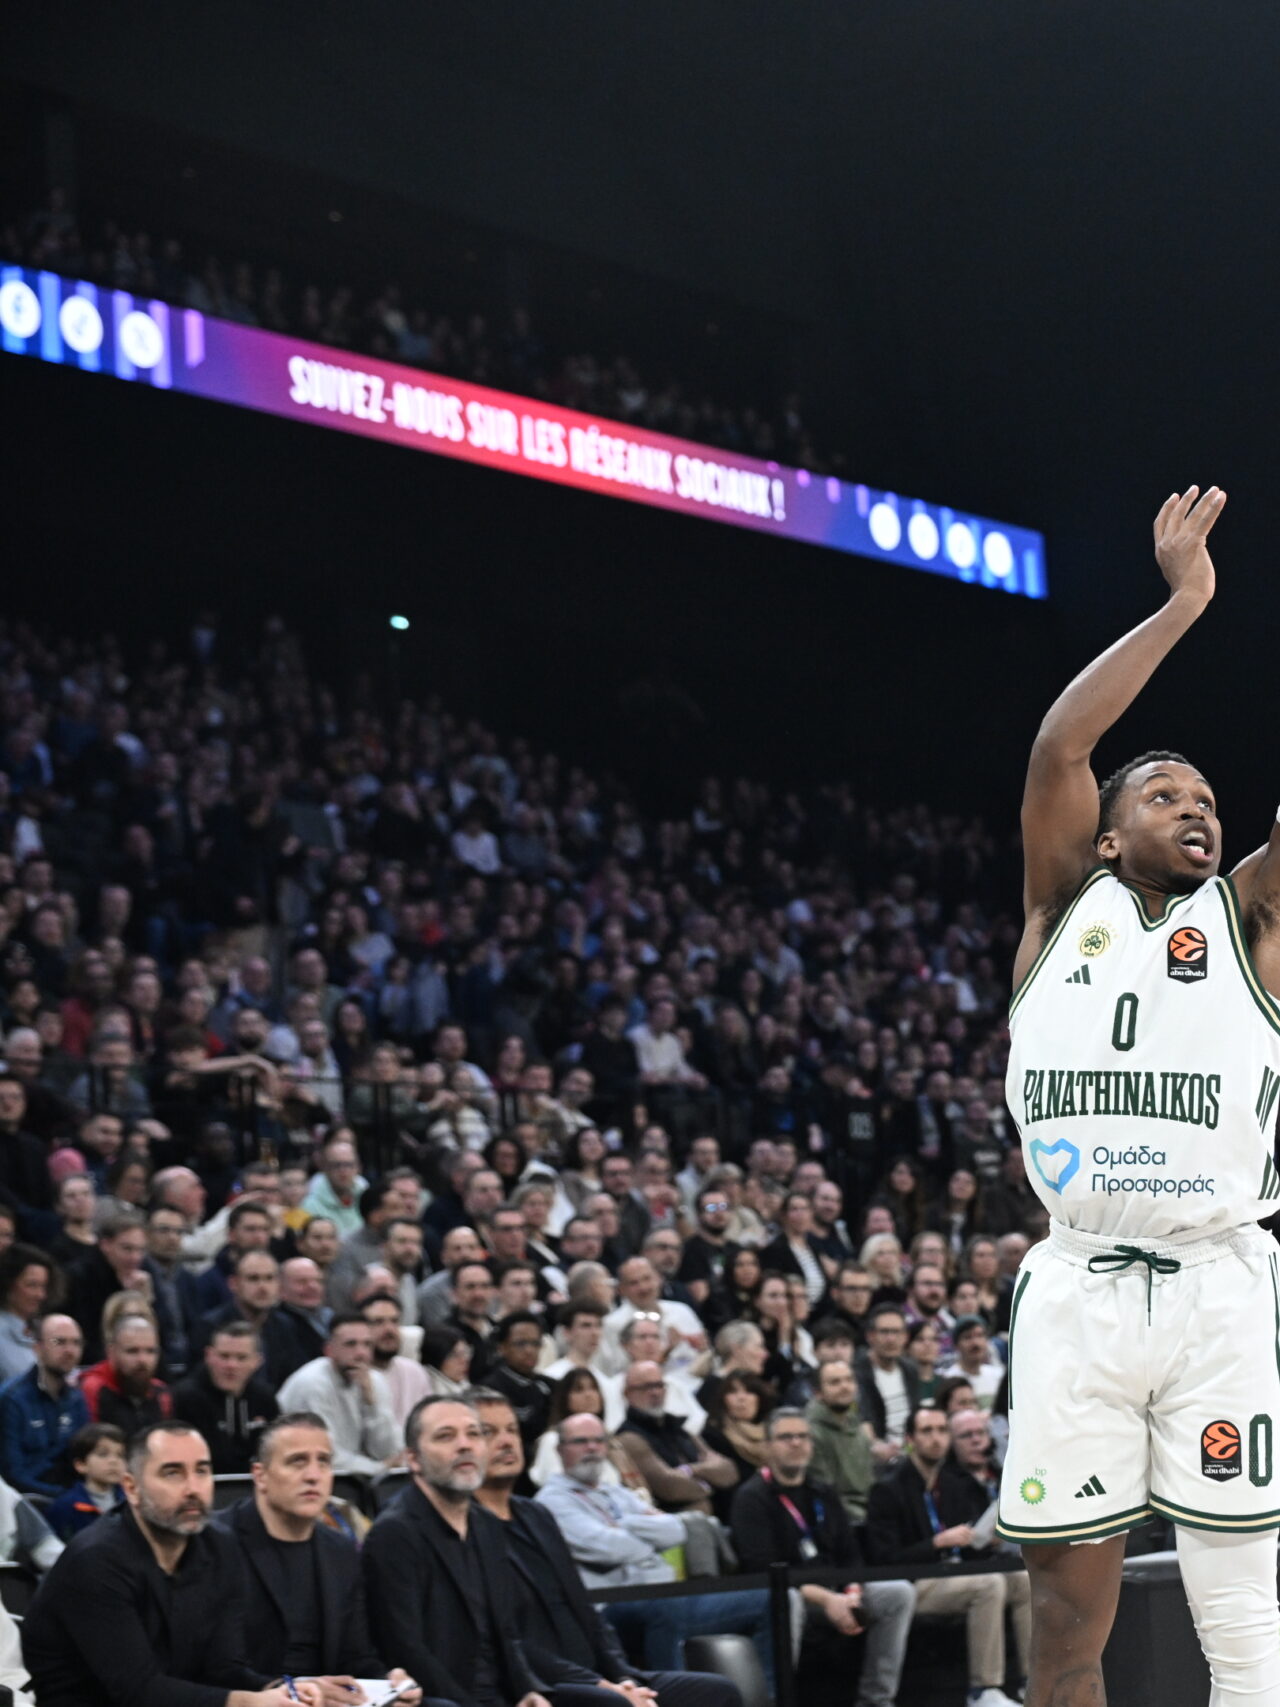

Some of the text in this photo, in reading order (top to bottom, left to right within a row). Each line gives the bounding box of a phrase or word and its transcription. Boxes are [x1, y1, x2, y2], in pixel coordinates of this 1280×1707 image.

[465, 401, 519, 455] SUR
[521, 415, 568, 467] LES
[1112, 992, 1139, 1051] 0
[1023, 1068, 1221, 1130] PANATHINAIKOS
[1091, 1173, 1215, 1198] Προσφοράς
[1092, 1145, 1166, 1169] Ομάδα
[1249, 1413, 1272, 1487] 0
